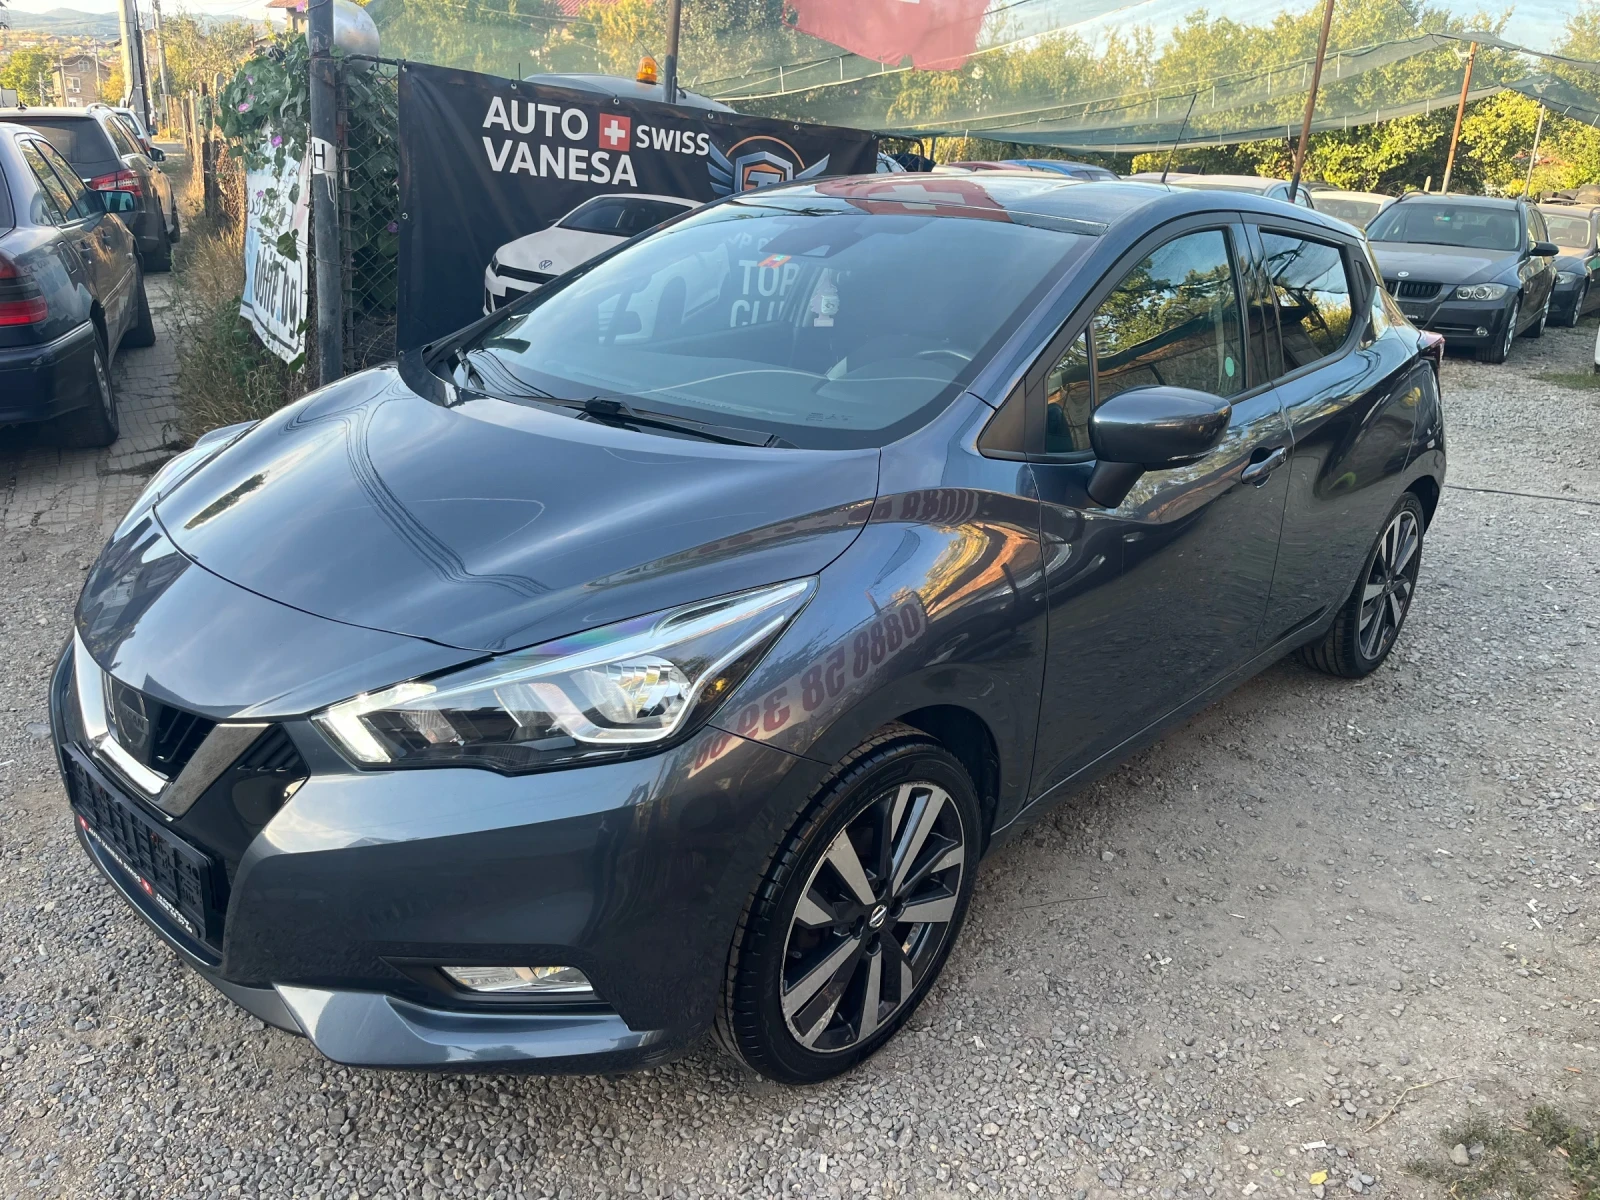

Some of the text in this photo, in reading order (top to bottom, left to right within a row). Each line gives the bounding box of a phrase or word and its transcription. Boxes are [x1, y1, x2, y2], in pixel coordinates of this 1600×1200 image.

[482, 96, 589, 141] AUTO
[636, 125, 710, 156] SWISS
[482, 137, 638, 187] VANESA
[739, 260, 800, 297] TOP
